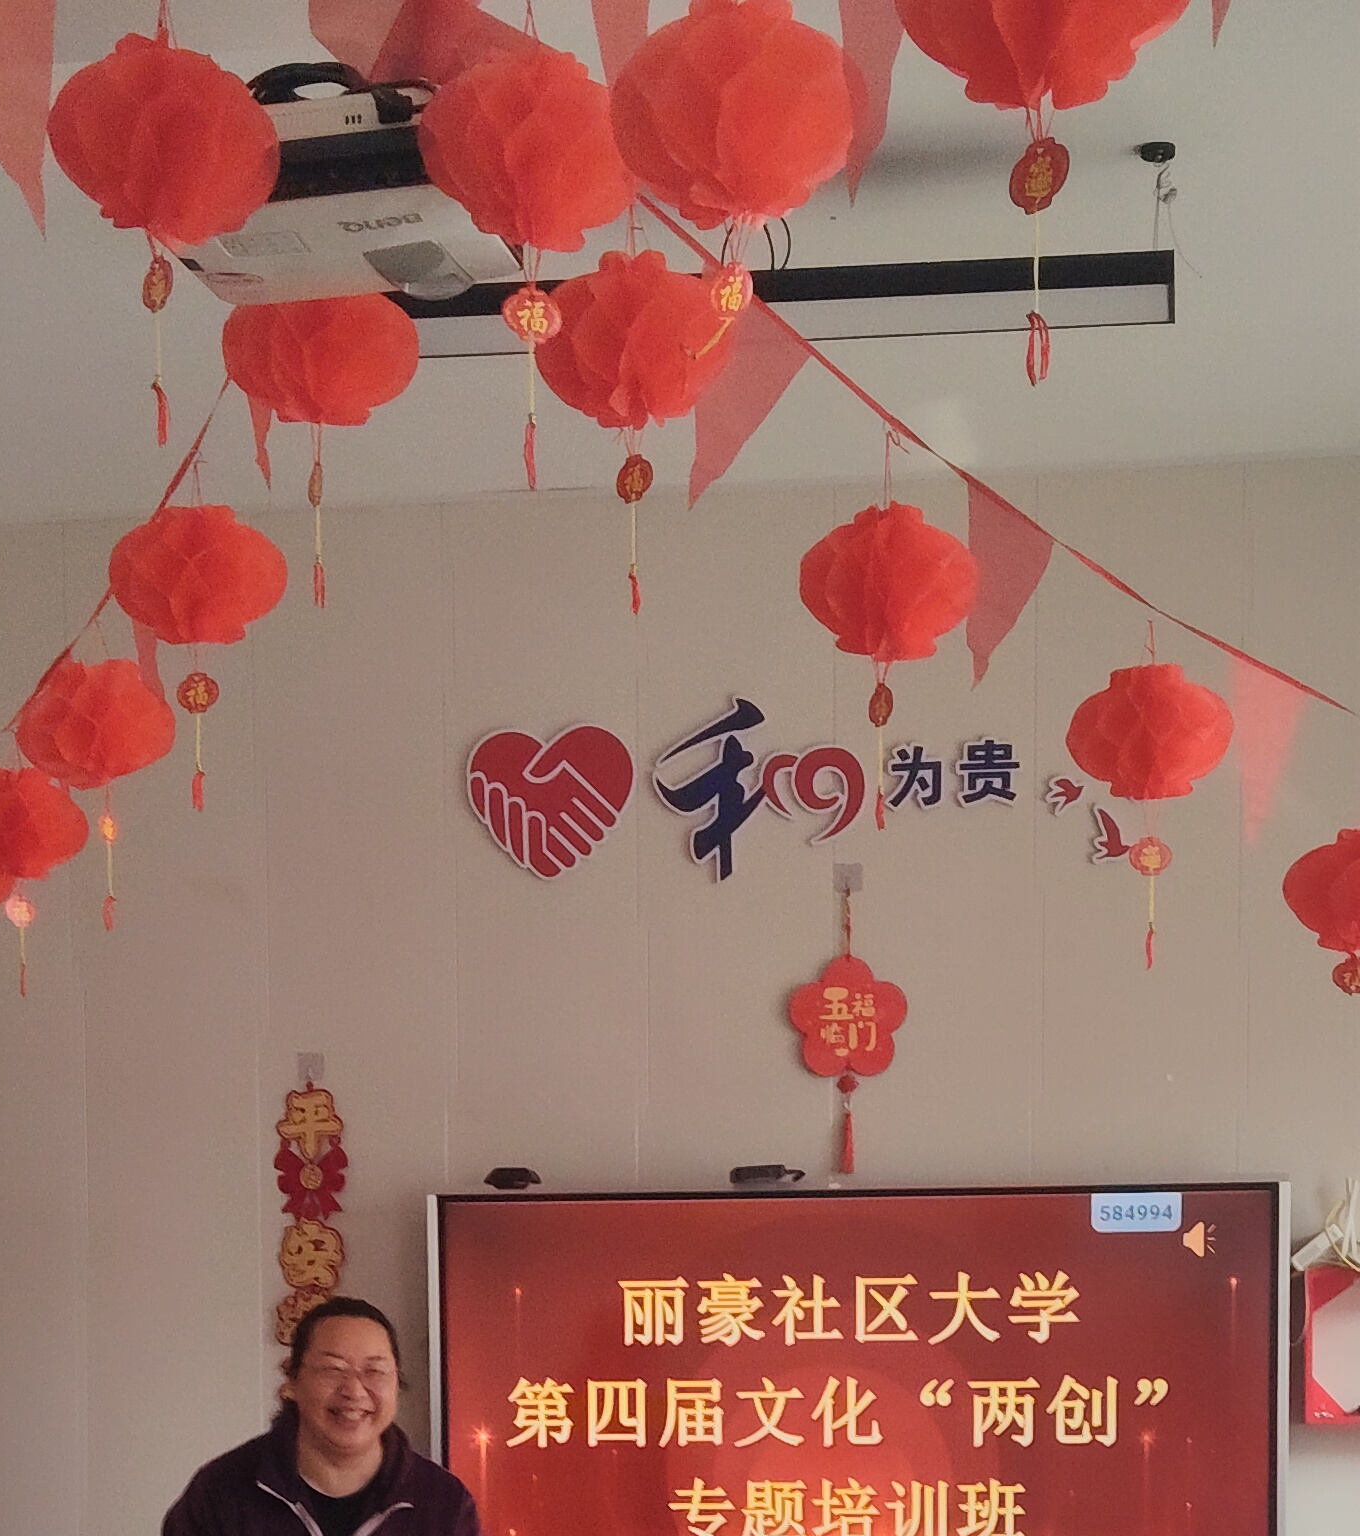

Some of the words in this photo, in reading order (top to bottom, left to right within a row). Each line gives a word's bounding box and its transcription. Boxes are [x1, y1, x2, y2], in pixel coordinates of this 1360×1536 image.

[720, 275, 744, 312] 福
[516, 299, 549, 334] 福
[1099, 1204, 1174, 1222] 584994
[618, 1271, 1081, 1346] 丽豪社区大学
